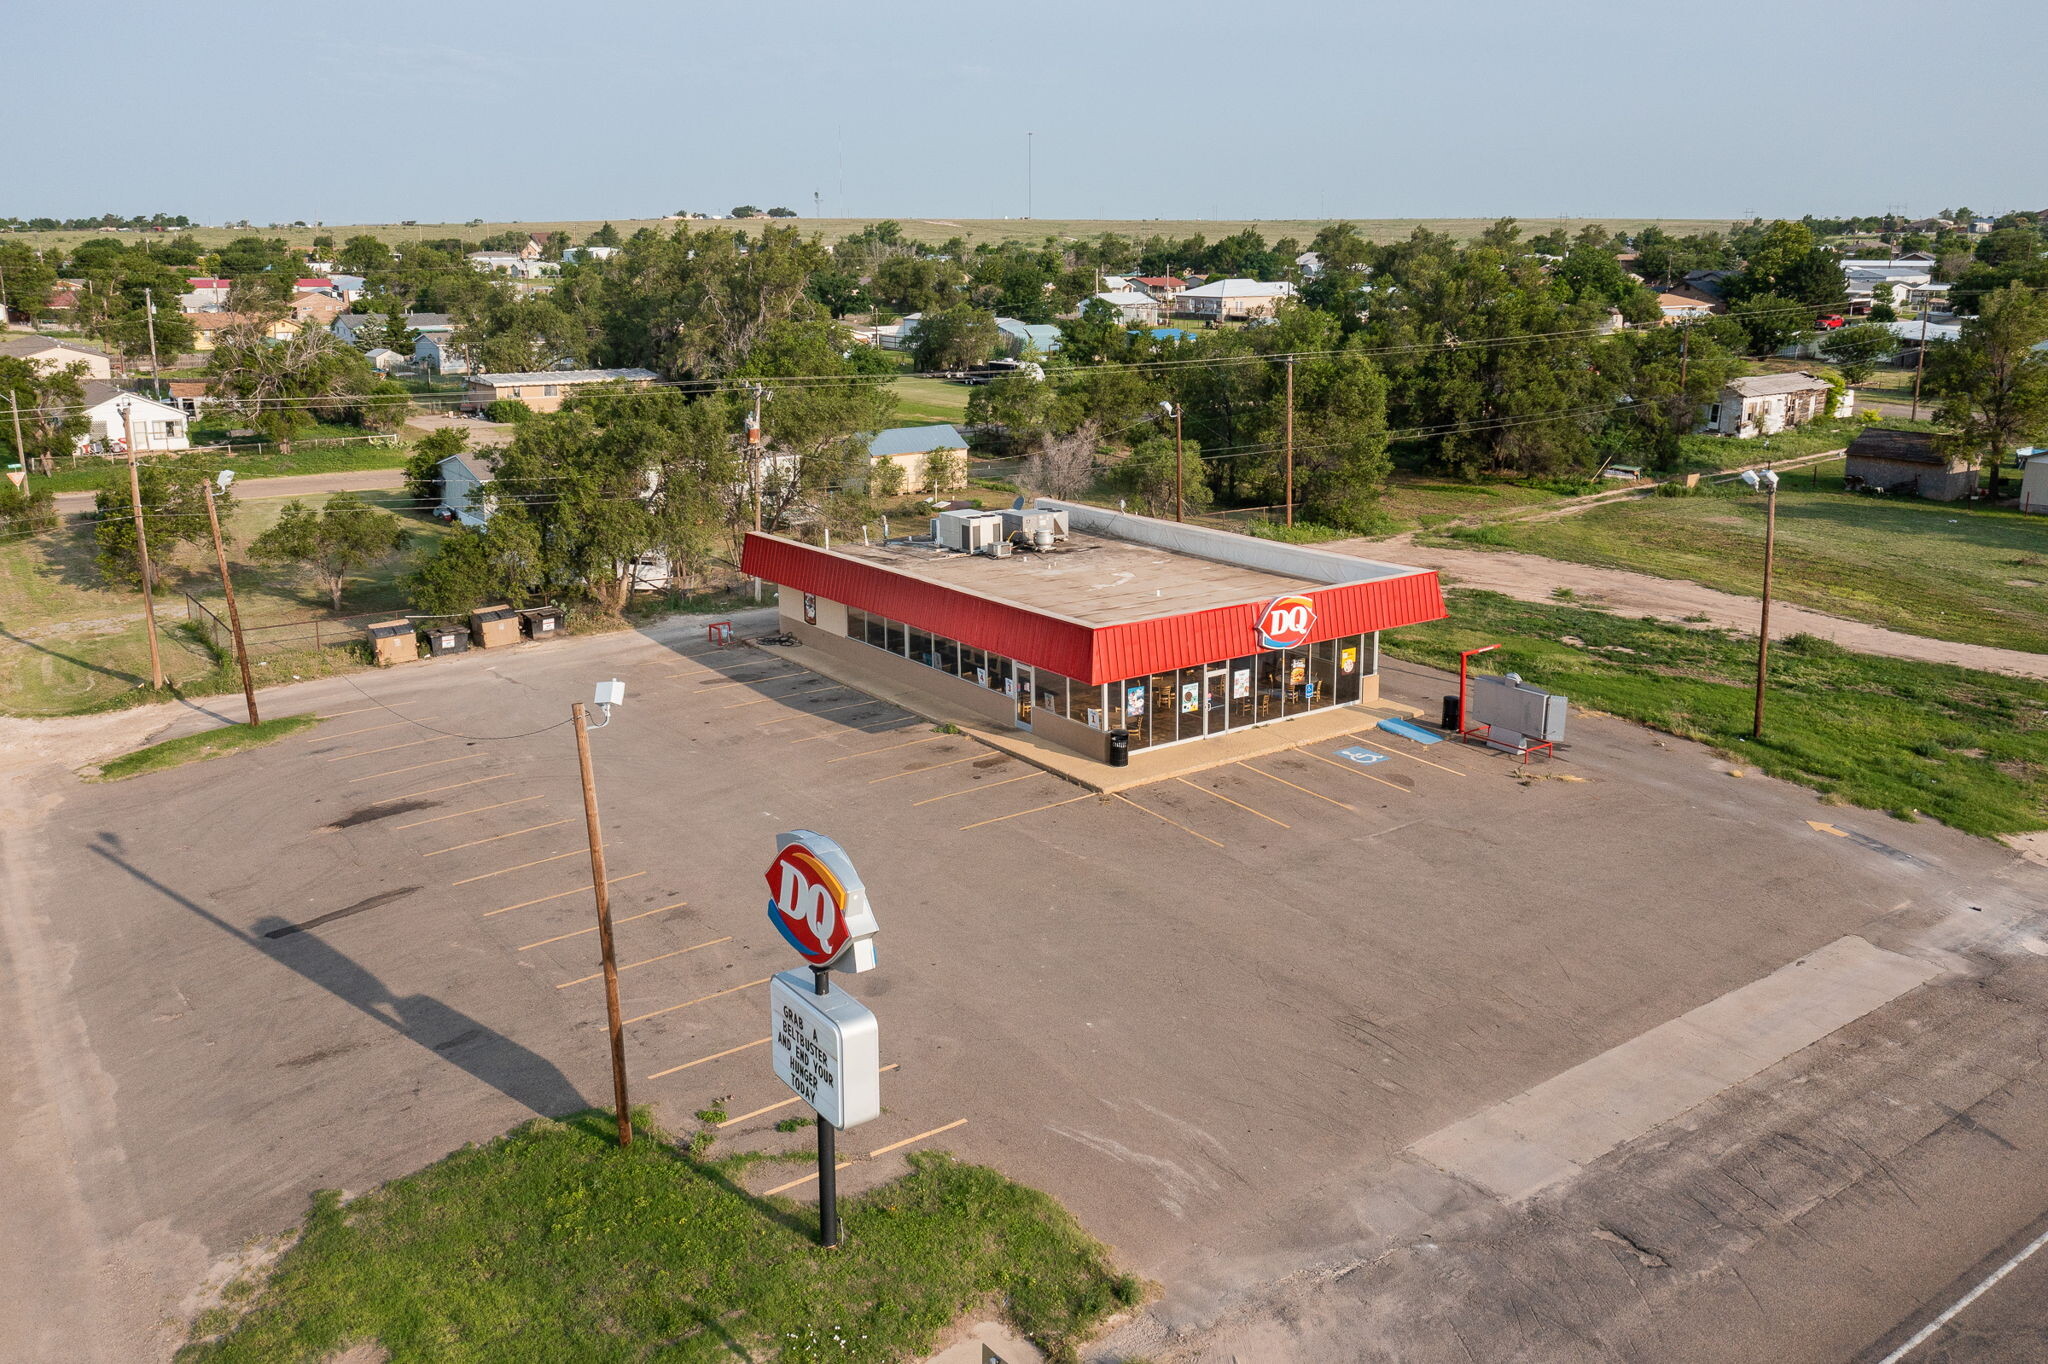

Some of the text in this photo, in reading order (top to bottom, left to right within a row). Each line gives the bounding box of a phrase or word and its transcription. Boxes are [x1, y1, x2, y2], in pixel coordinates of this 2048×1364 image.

[1270, 606, 1308, 635] DQ
[1091, 714, 1096, 724] 1
[777, 859, 836, 955] DQ
[783, 1005, 818, 1042] GRAB A
[778, 1031, 834, 1088] AND END YOUR
[782, 1019, 828, 1068] BELTBUSTER
[789, 1055, 818, 1091] HUNGER
[790, 1072, 816, 1104] TODAY
